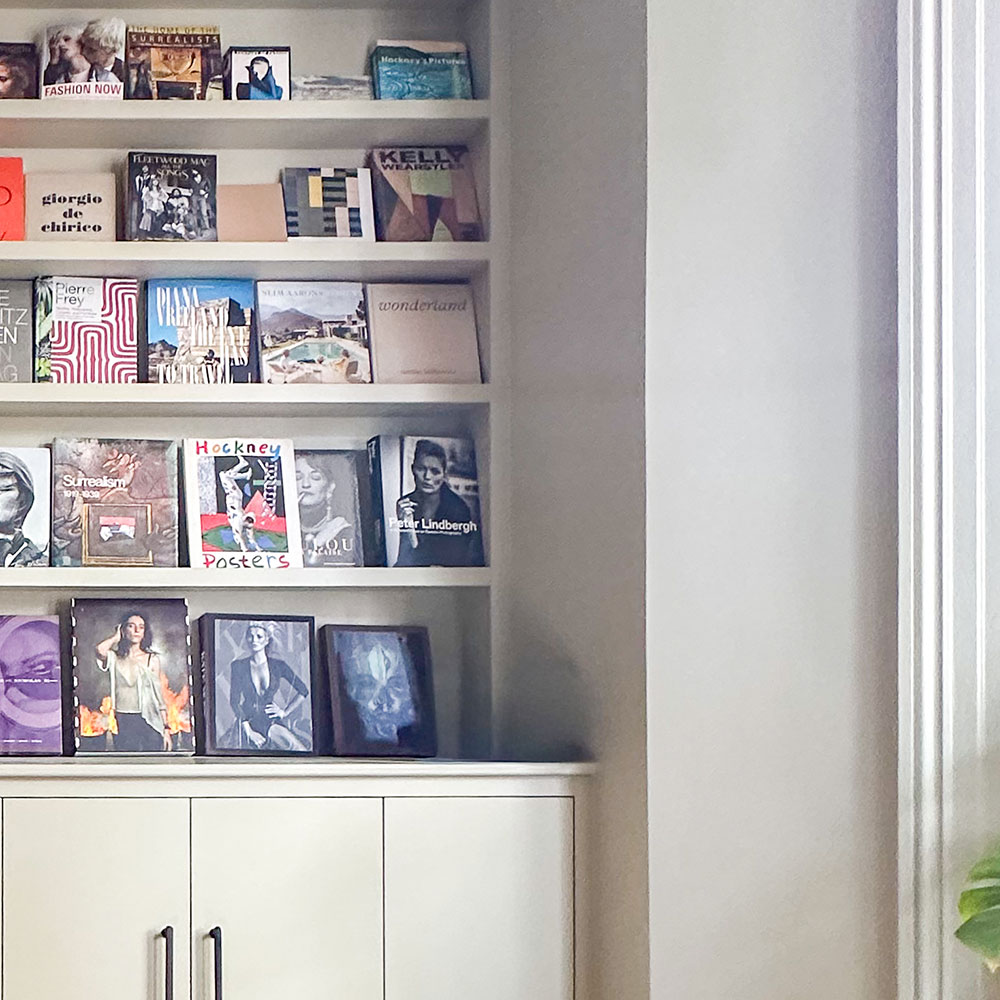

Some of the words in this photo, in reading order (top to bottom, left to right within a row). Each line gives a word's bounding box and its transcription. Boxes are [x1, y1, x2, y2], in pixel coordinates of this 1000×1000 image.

[131, 35, 218, 44] SURREALISTS
[45, 85, 91, 97] FASHION
[95, 85, 121, 95] NOW
[133, 154, 187, 164] FLEETWOOD
[379, 150, 464, 163] KELLY
[156, 168, 189, 180] SONGS
[42, 193, 103, 206] giorgio
[62, 208, 83, 219] de
[41, 221, 102, 234] chirico
[56, 282, 95, 295] Pierre
[56, 294, 85, 308] Frey
[156, 286, 200, 308] DIANA
[378, 298, 467, 313] wonderland
[195, 440, 281, 458] Hockney
[62, 474, 126, 489] Surrealism
[388, 518, 419, 529] Peter
[422, 518, 478, 534] Lindbergh
[202, 553, 290, 569] Posters
